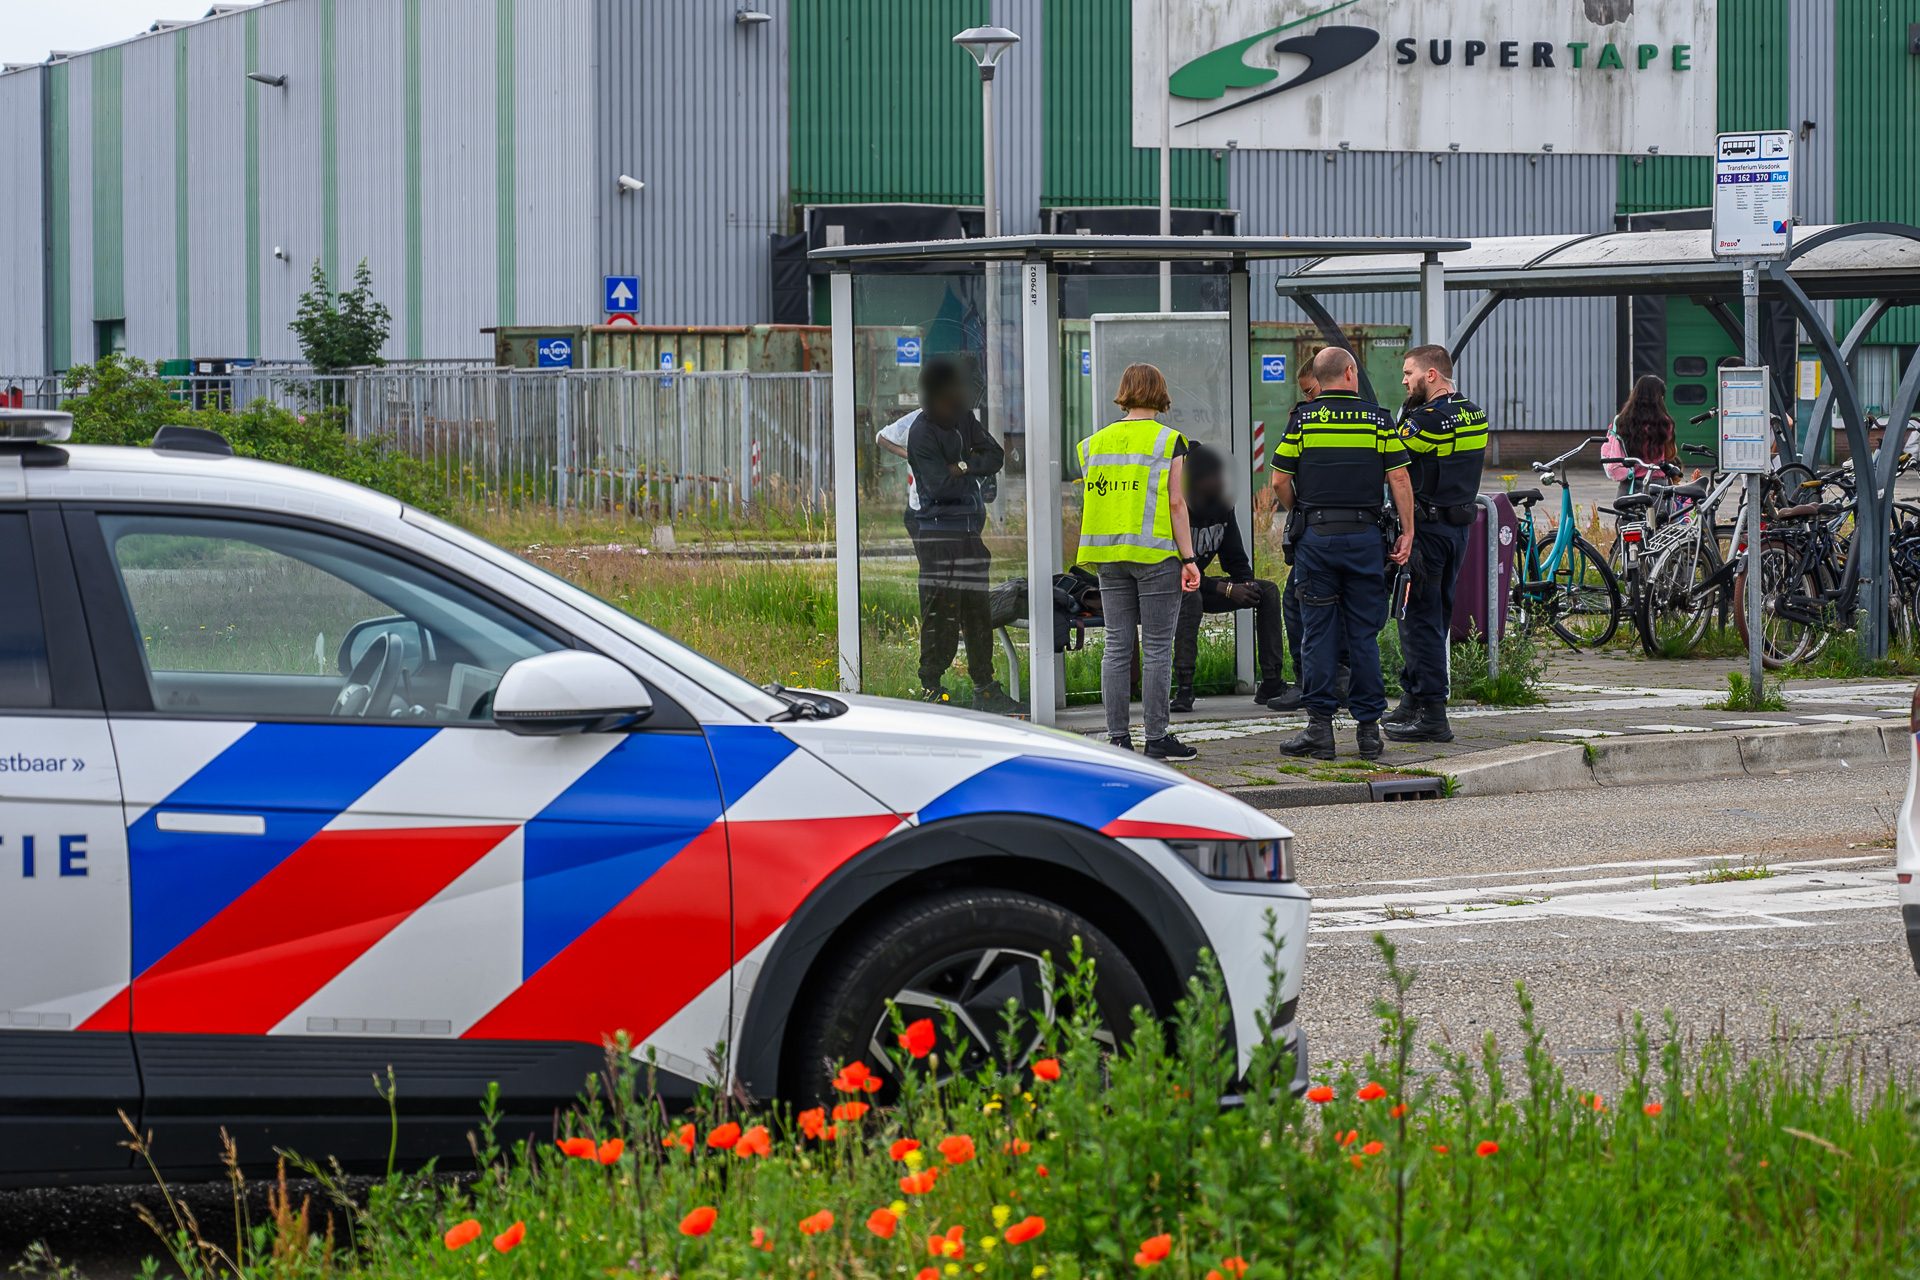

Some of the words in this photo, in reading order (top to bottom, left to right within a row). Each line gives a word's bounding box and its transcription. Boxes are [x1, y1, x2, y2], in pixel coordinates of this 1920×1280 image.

[1395, 37, 1691, 71] SUPERTAPE
[1720, 174, 1732, 183] 162
[1738, 174, 1750, 182] 162
[1755, 173, 1769, 182] 370
[1772, 173, 1787, 181] Flex
[1720, 240, 1738, 248] Bravo
[1311, 408, 1368, 421] POLITIE
[1087, 475, 1140, 494] POLITIE
[0, 834, 89, 878] IE
